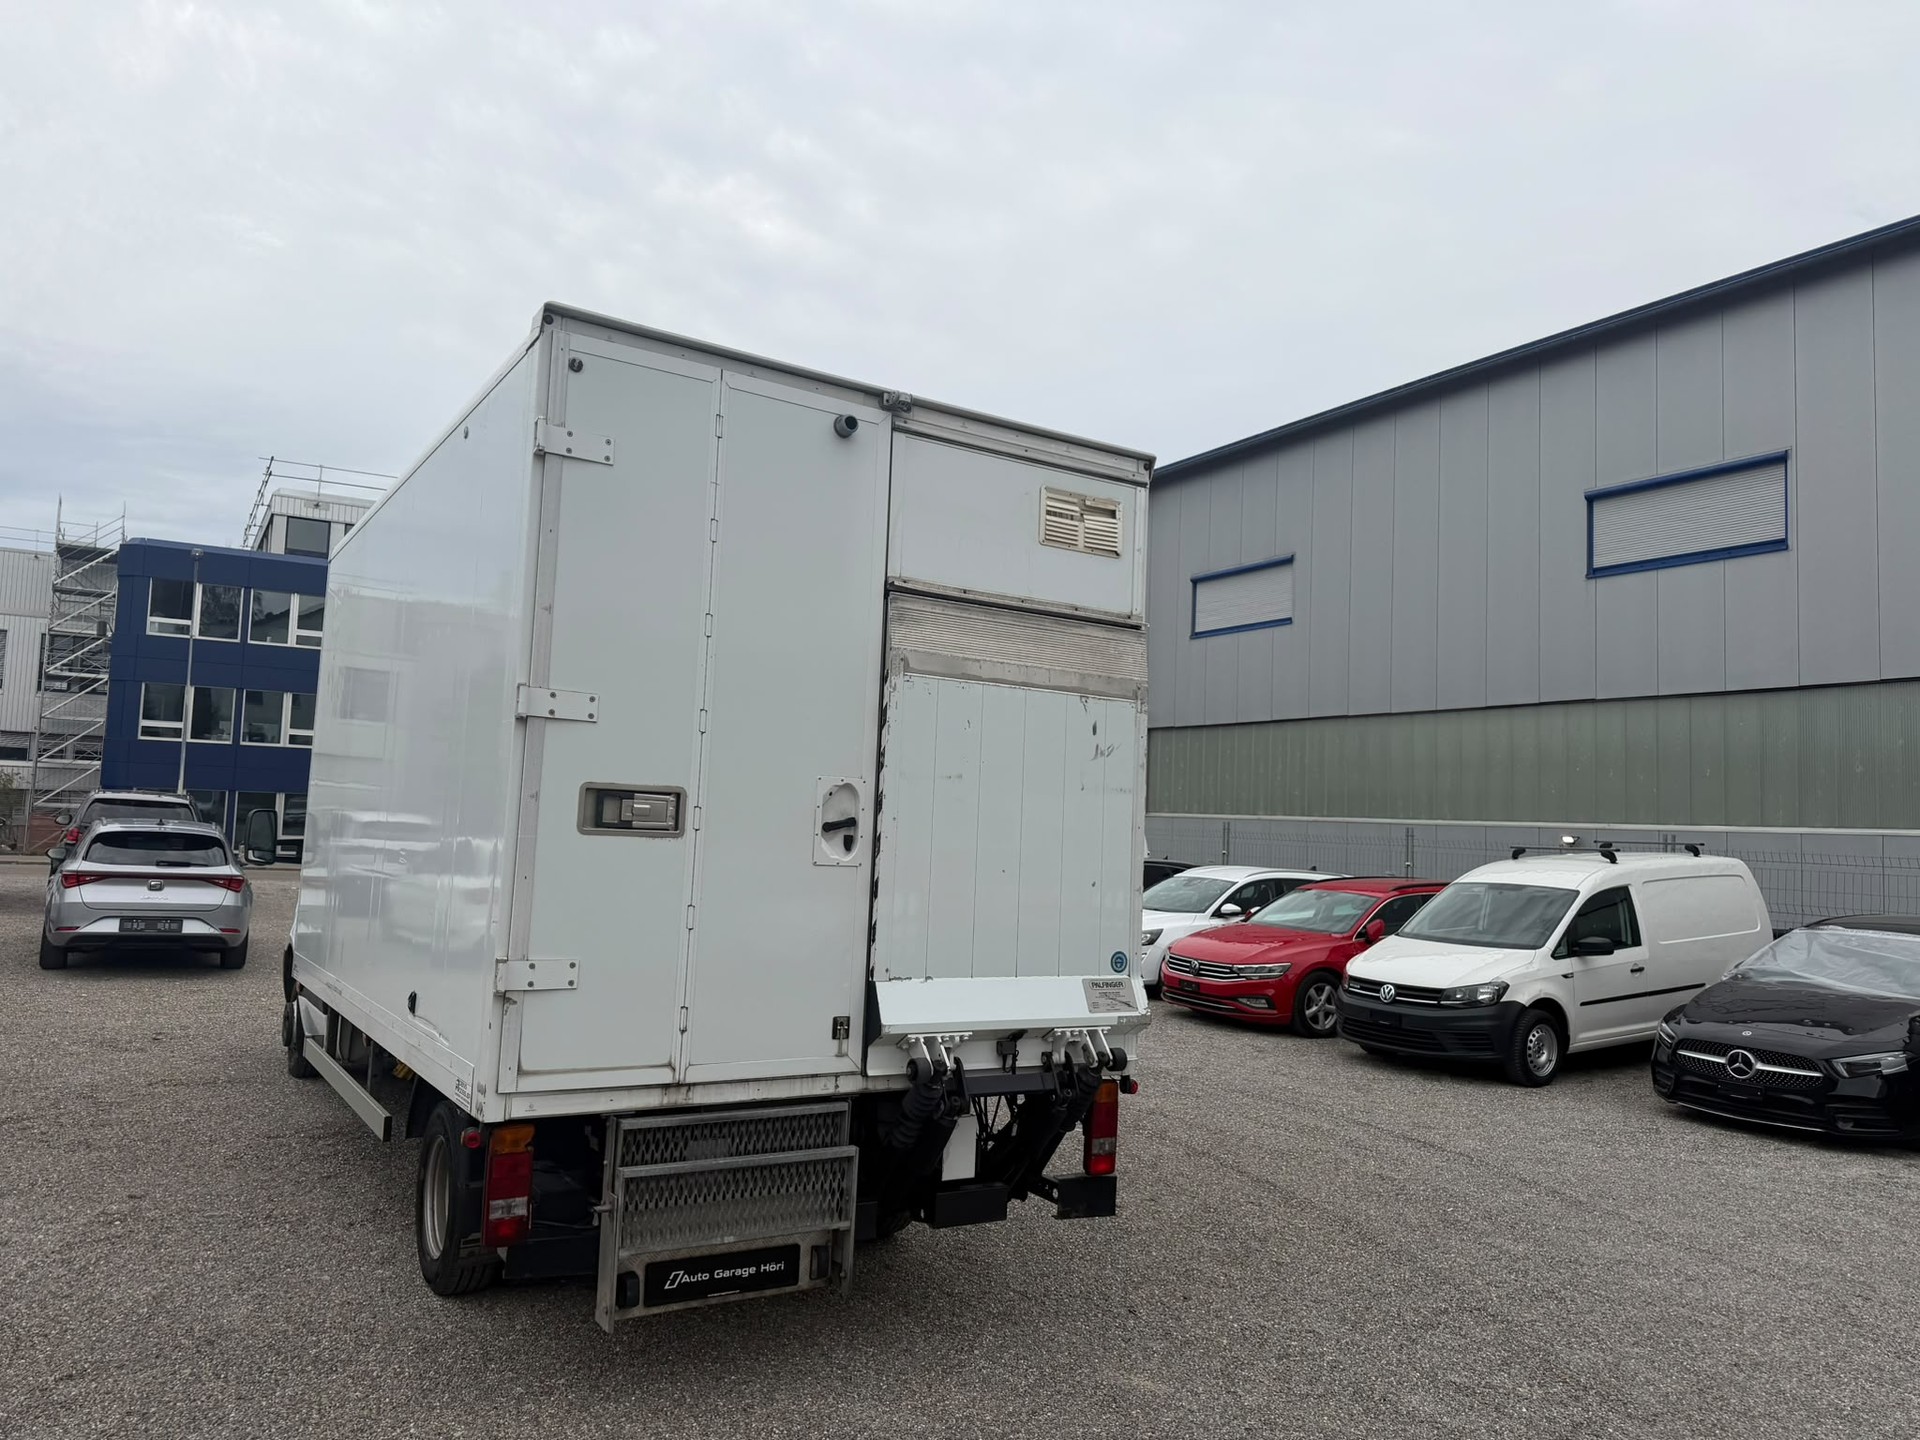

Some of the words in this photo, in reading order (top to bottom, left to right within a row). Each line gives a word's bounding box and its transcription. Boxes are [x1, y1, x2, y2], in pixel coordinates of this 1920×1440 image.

[1091, 981, 1124, 989] PALFINGER
[681, 1272, 710, 1284] Auto
[714, 1266, 757, 1278] Garage
[760, 1261, 785, 1273] Höri
